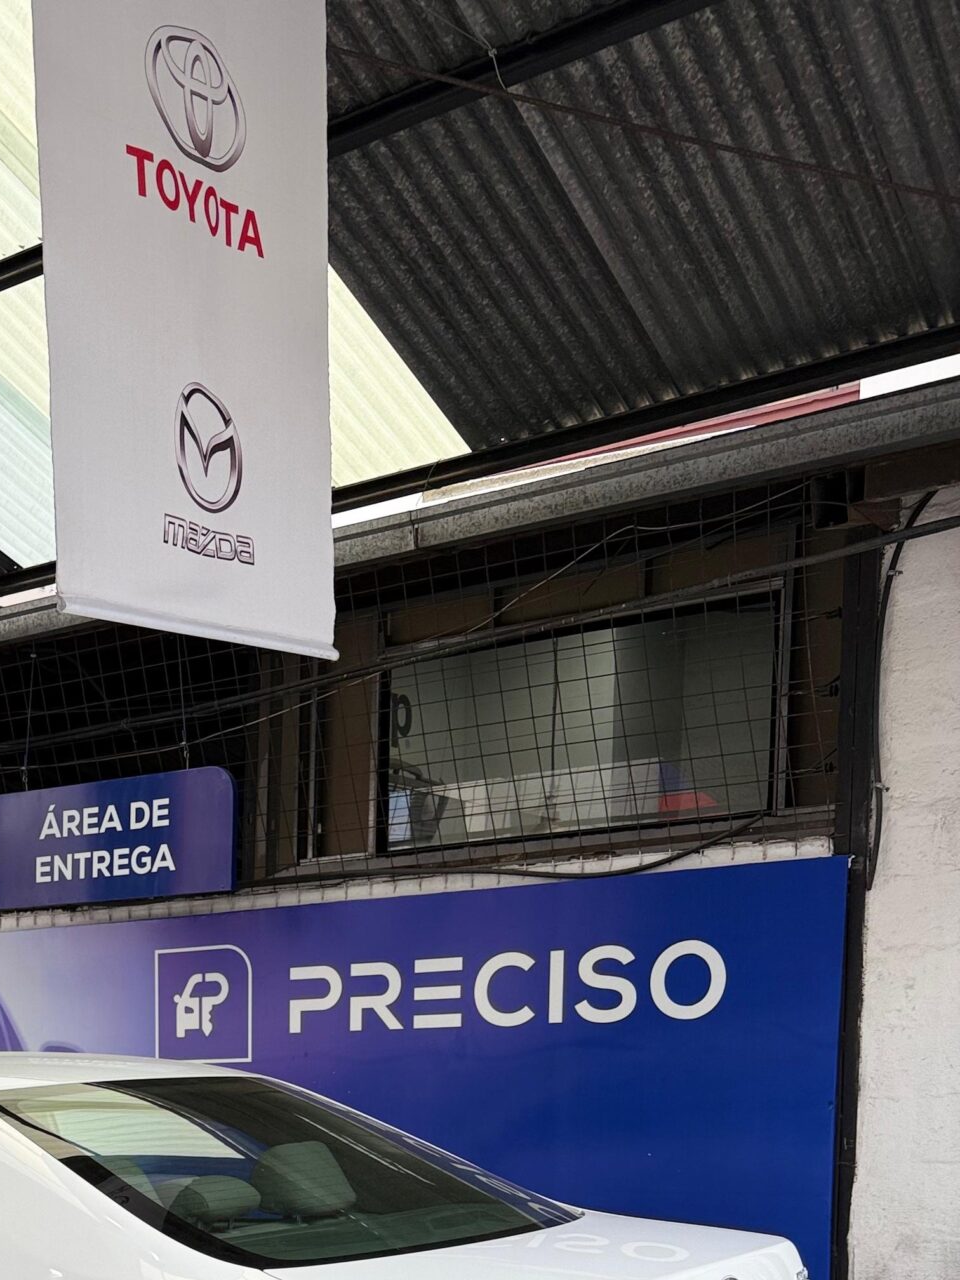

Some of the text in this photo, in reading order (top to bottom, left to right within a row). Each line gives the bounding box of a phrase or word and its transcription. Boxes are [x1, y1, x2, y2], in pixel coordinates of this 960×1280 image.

[125, 144, 264, 258] TOYOTA
[39, 798, 170, 840] ÁREA DE
[35, 843, 176, 884] ENTREGA
[289, 939, 727, 1034] PRECISO
